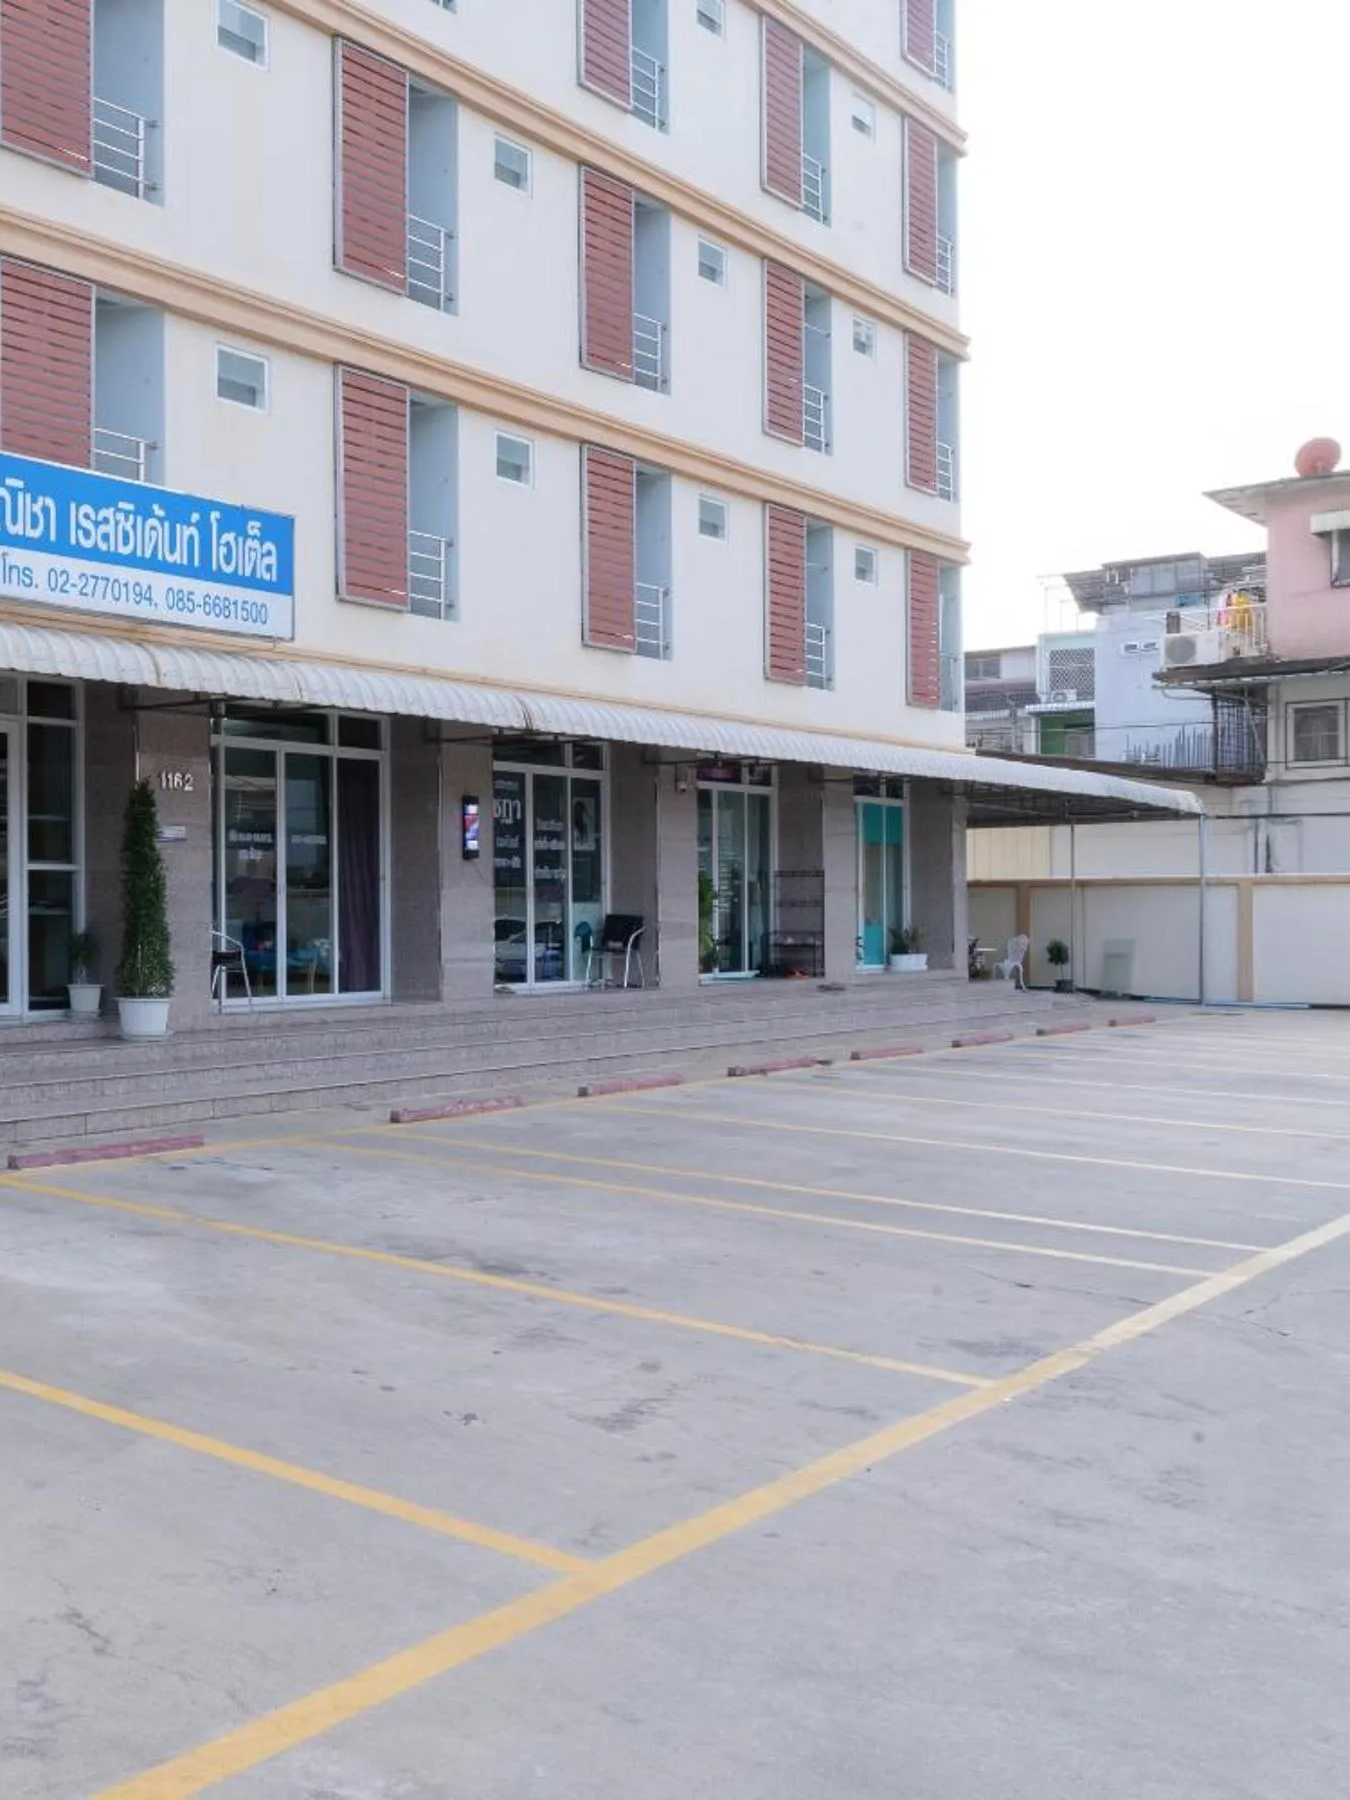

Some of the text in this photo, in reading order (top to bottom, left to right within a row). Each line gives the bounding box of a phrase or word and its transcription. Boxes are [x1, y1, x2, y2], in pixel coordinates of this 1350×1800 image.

[70, 501, 198, 567] เรสซิเด้นท์
[210, 511, 277, 581] โฮเต็ล
[2, 552, 39, 588] โทร.
[166, 587, 267, 624] 085-6681500
[160, 771, 194, 791] 1162
